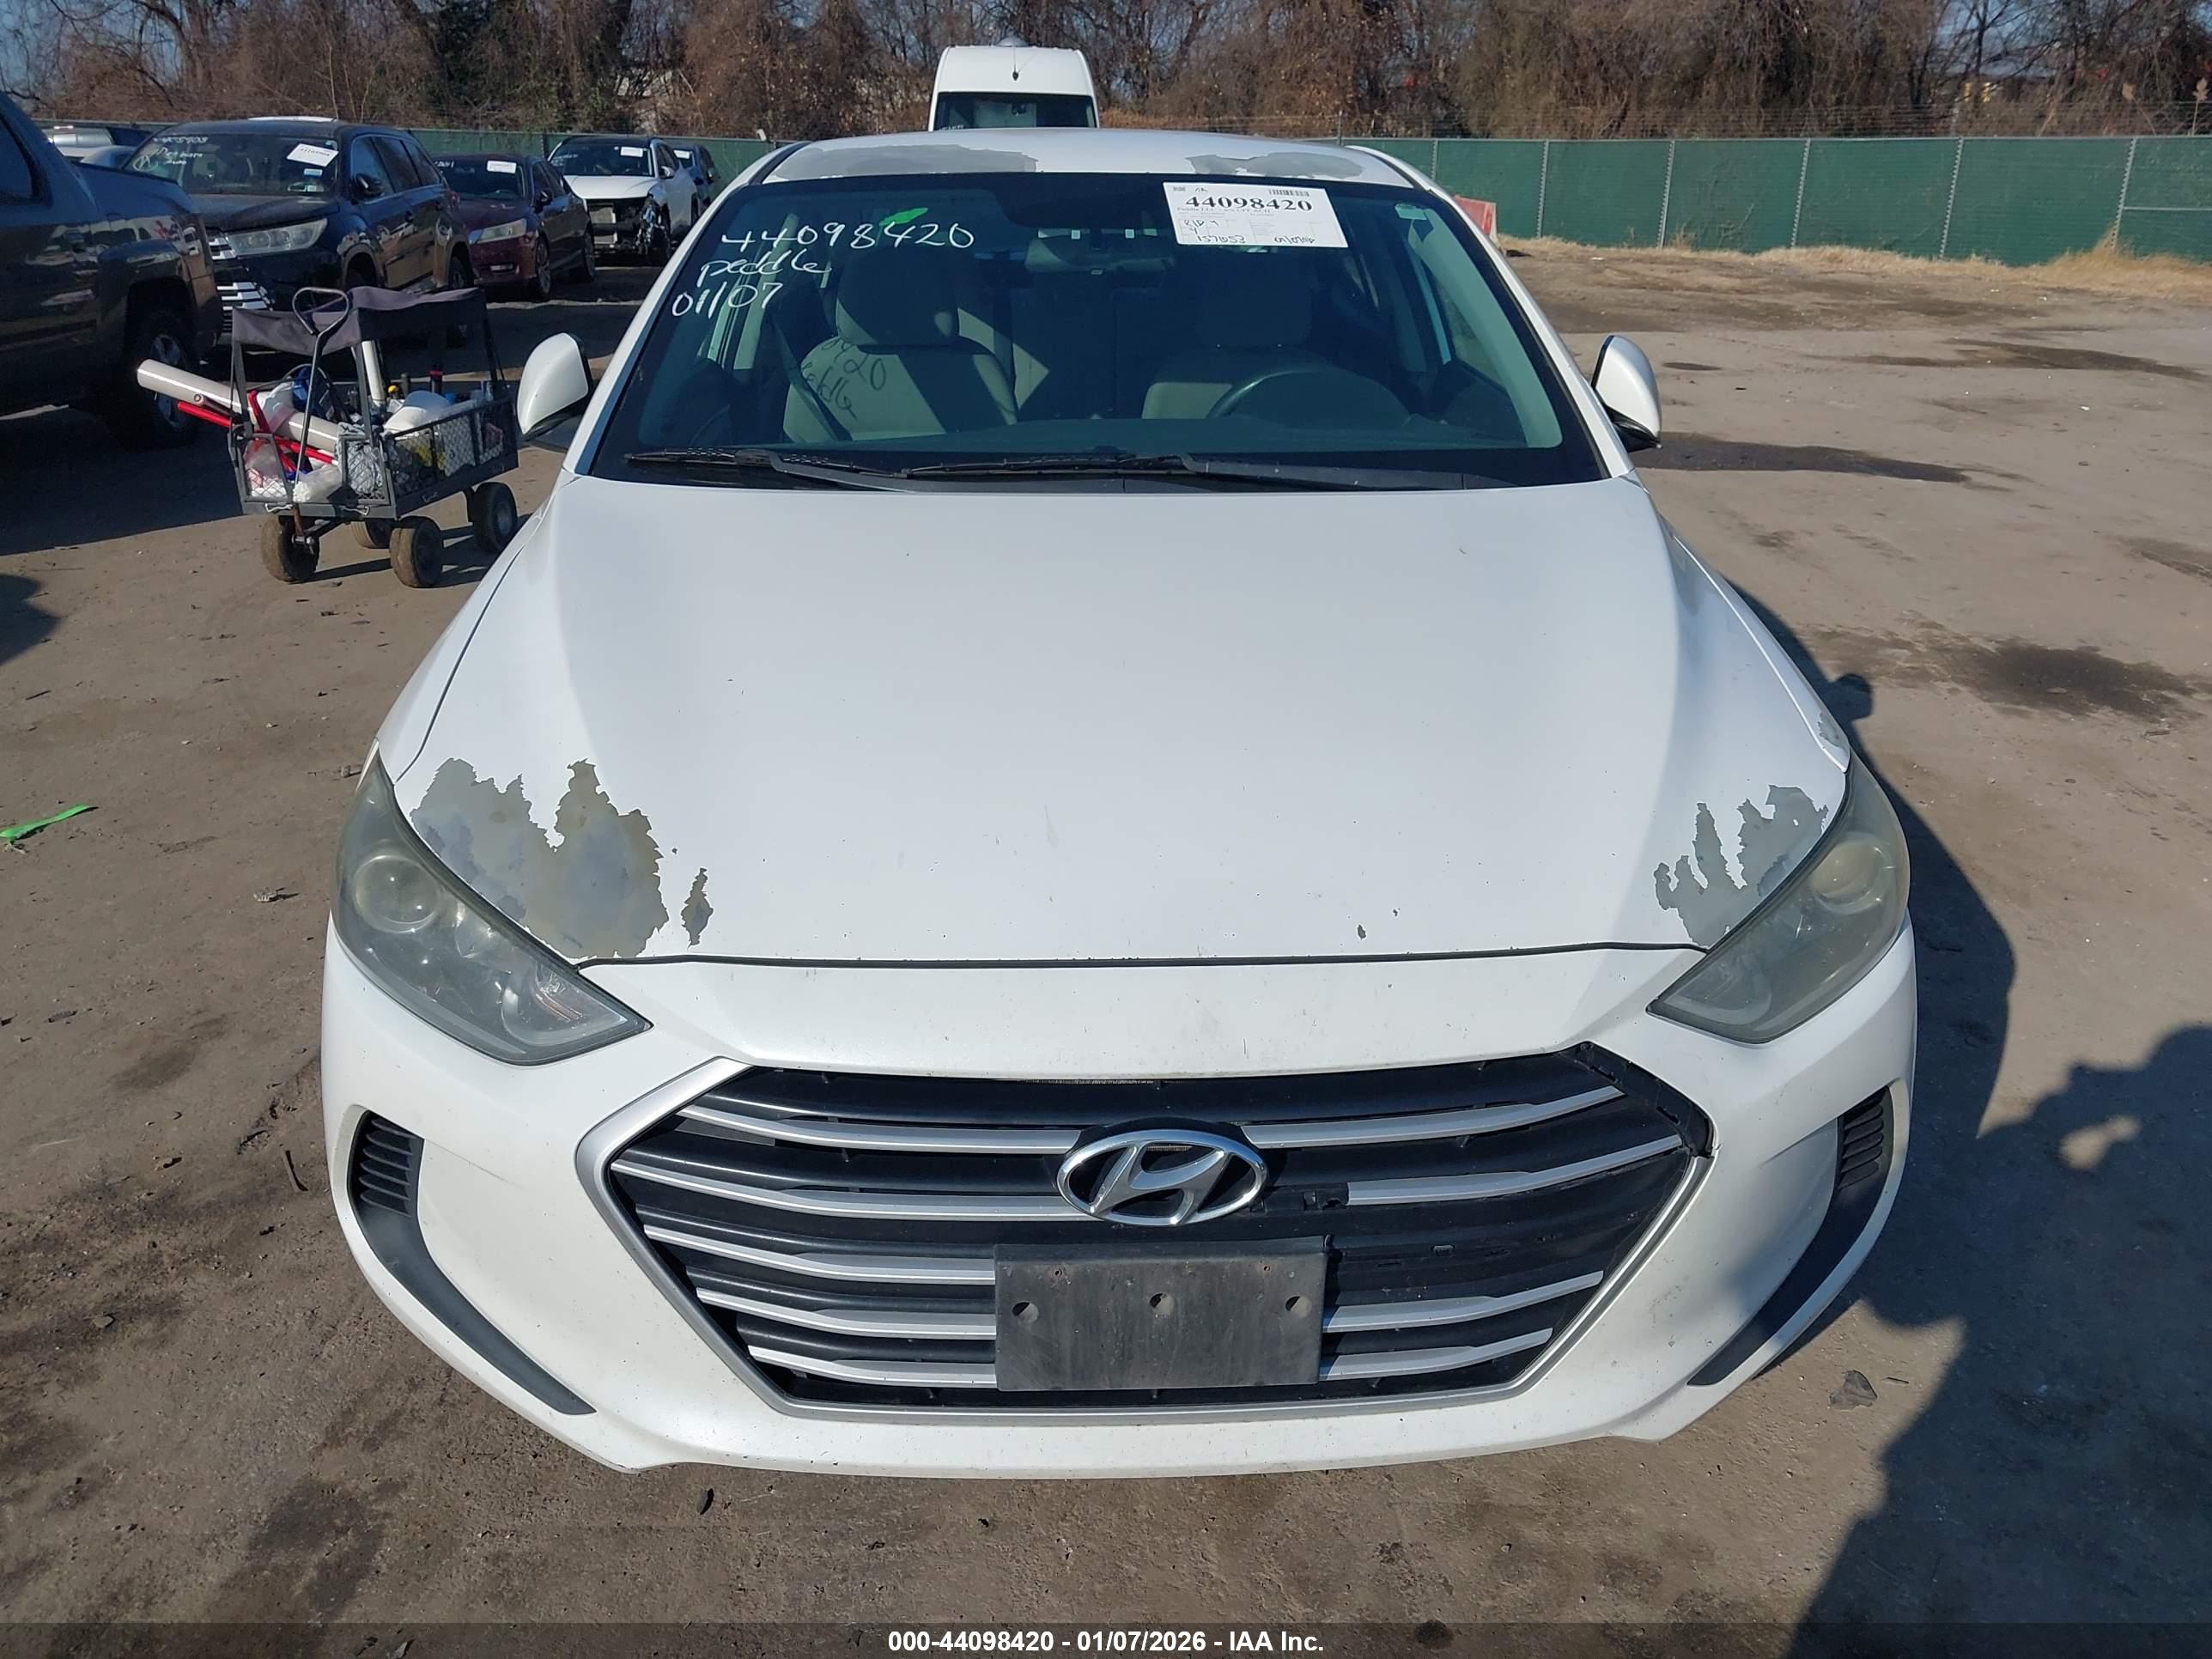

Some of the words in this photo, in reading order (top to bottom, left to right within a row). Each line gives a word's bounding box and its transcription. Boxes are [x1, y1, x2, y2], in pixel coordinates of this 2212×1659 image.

[1186, 196, 1312, 211] 44098420
[722, 222, 975, 252] 44098420
[672, 282, 783, 319] 01/07
